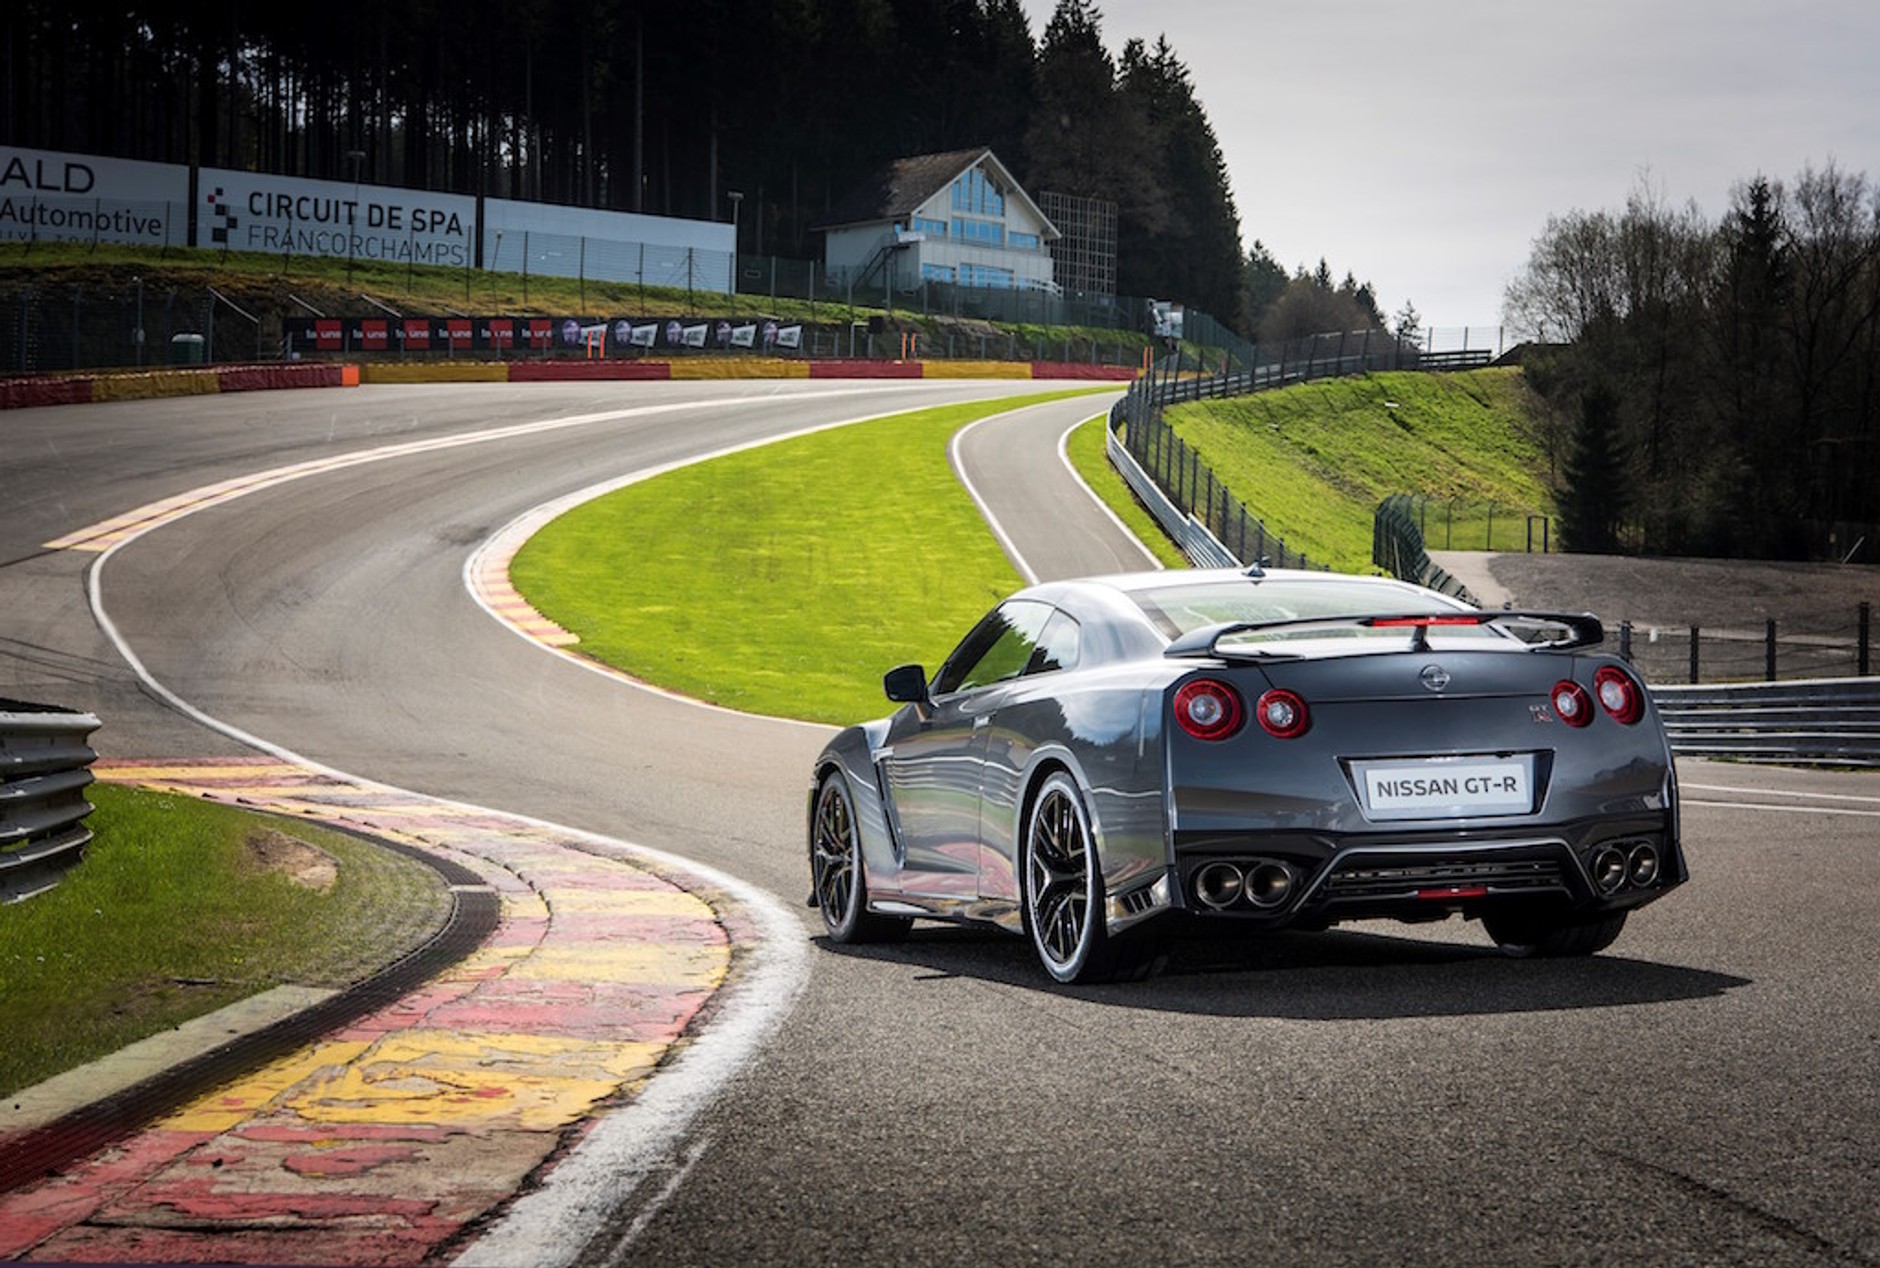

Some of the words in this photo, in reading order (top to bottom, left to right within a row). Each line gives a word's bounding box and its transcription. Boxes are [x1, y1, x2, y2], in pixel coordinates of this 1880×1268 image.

[0, 157, 95, 193] ALD
[0, 198, 162, 236] Automotive
[249, 192, 358, 225] CIRCUIT
[368, 203, 403, 230] DE
[411, 208, 464, 236] SPA
[248, 225, 464, 266] FRANCORCHAMPS
[1377, 779, 1459, 798] NISSAN
[1465, 776, 1518, 795] GT-R
